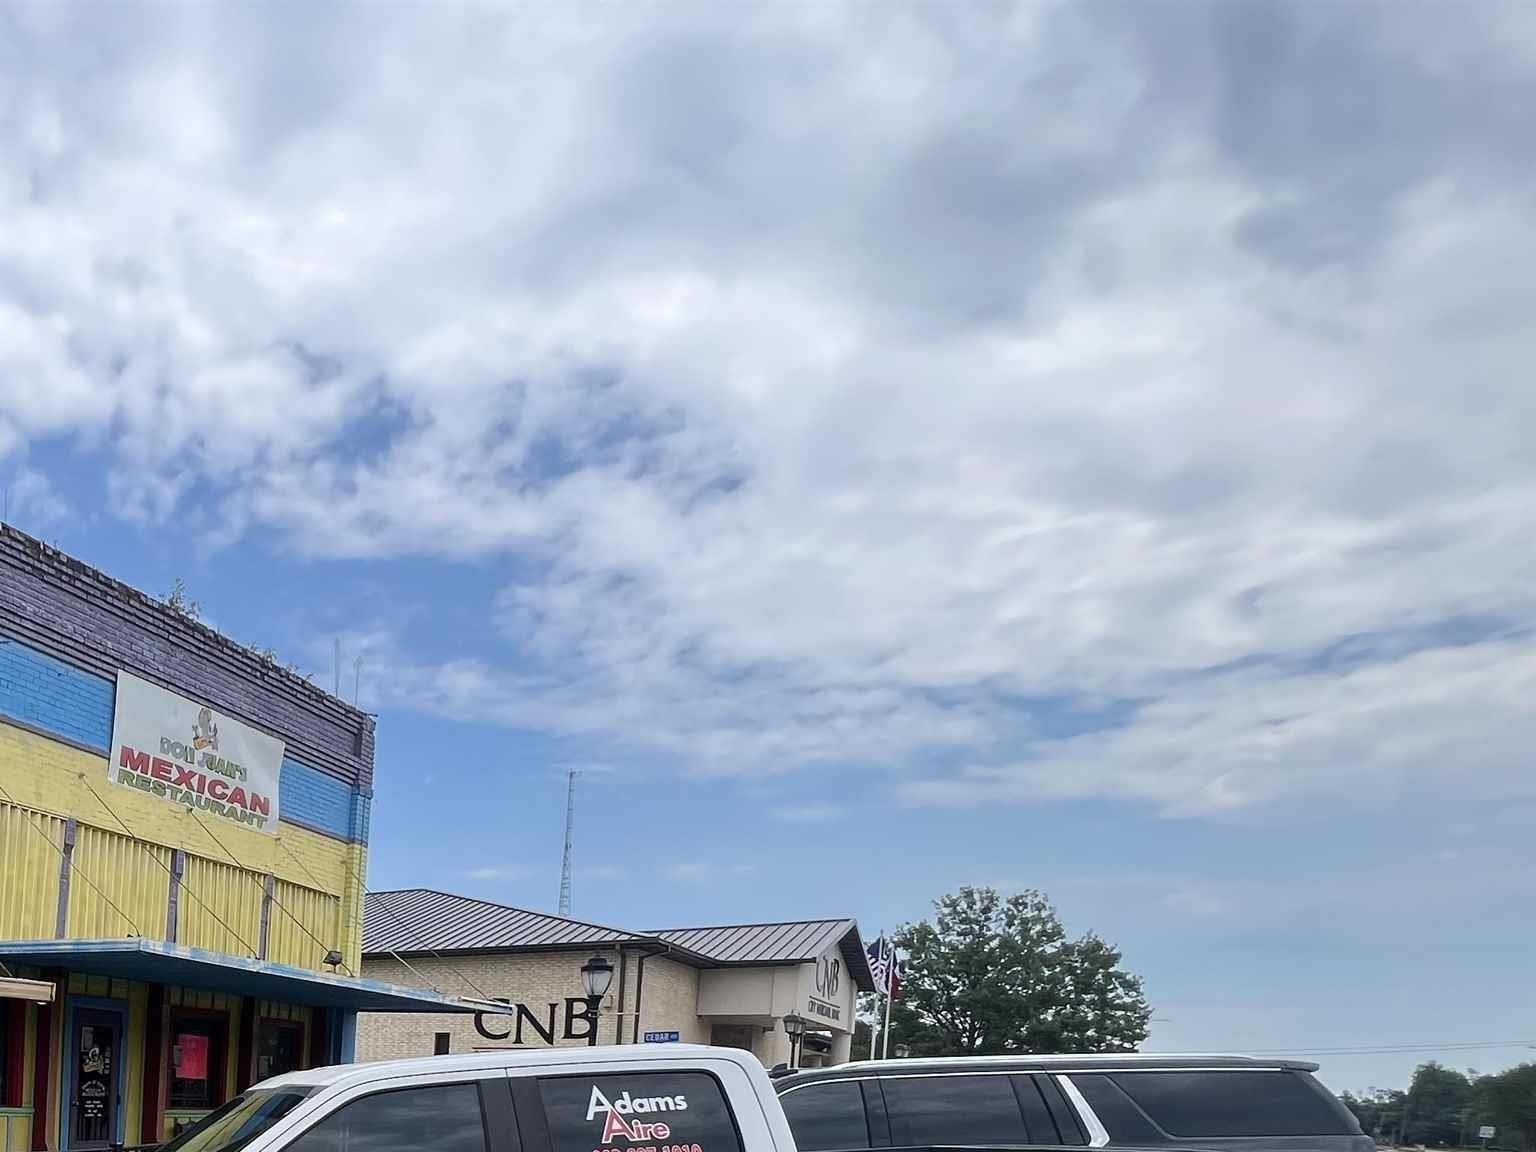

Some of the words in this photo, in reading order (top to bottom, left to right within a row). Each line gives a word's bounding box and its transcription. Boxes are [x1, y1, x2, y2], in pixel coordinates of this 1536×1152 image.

[118, 769, 268, 829] RESTAURANT
[120, 746, 270, 816] MEXICAN
[816, 956, 839, 1000] CNB
[474, 998, 593, 1046] CNB
[586, 1084, 688, 1120] Adams
[602, 1106, 670, 1144] Aire
